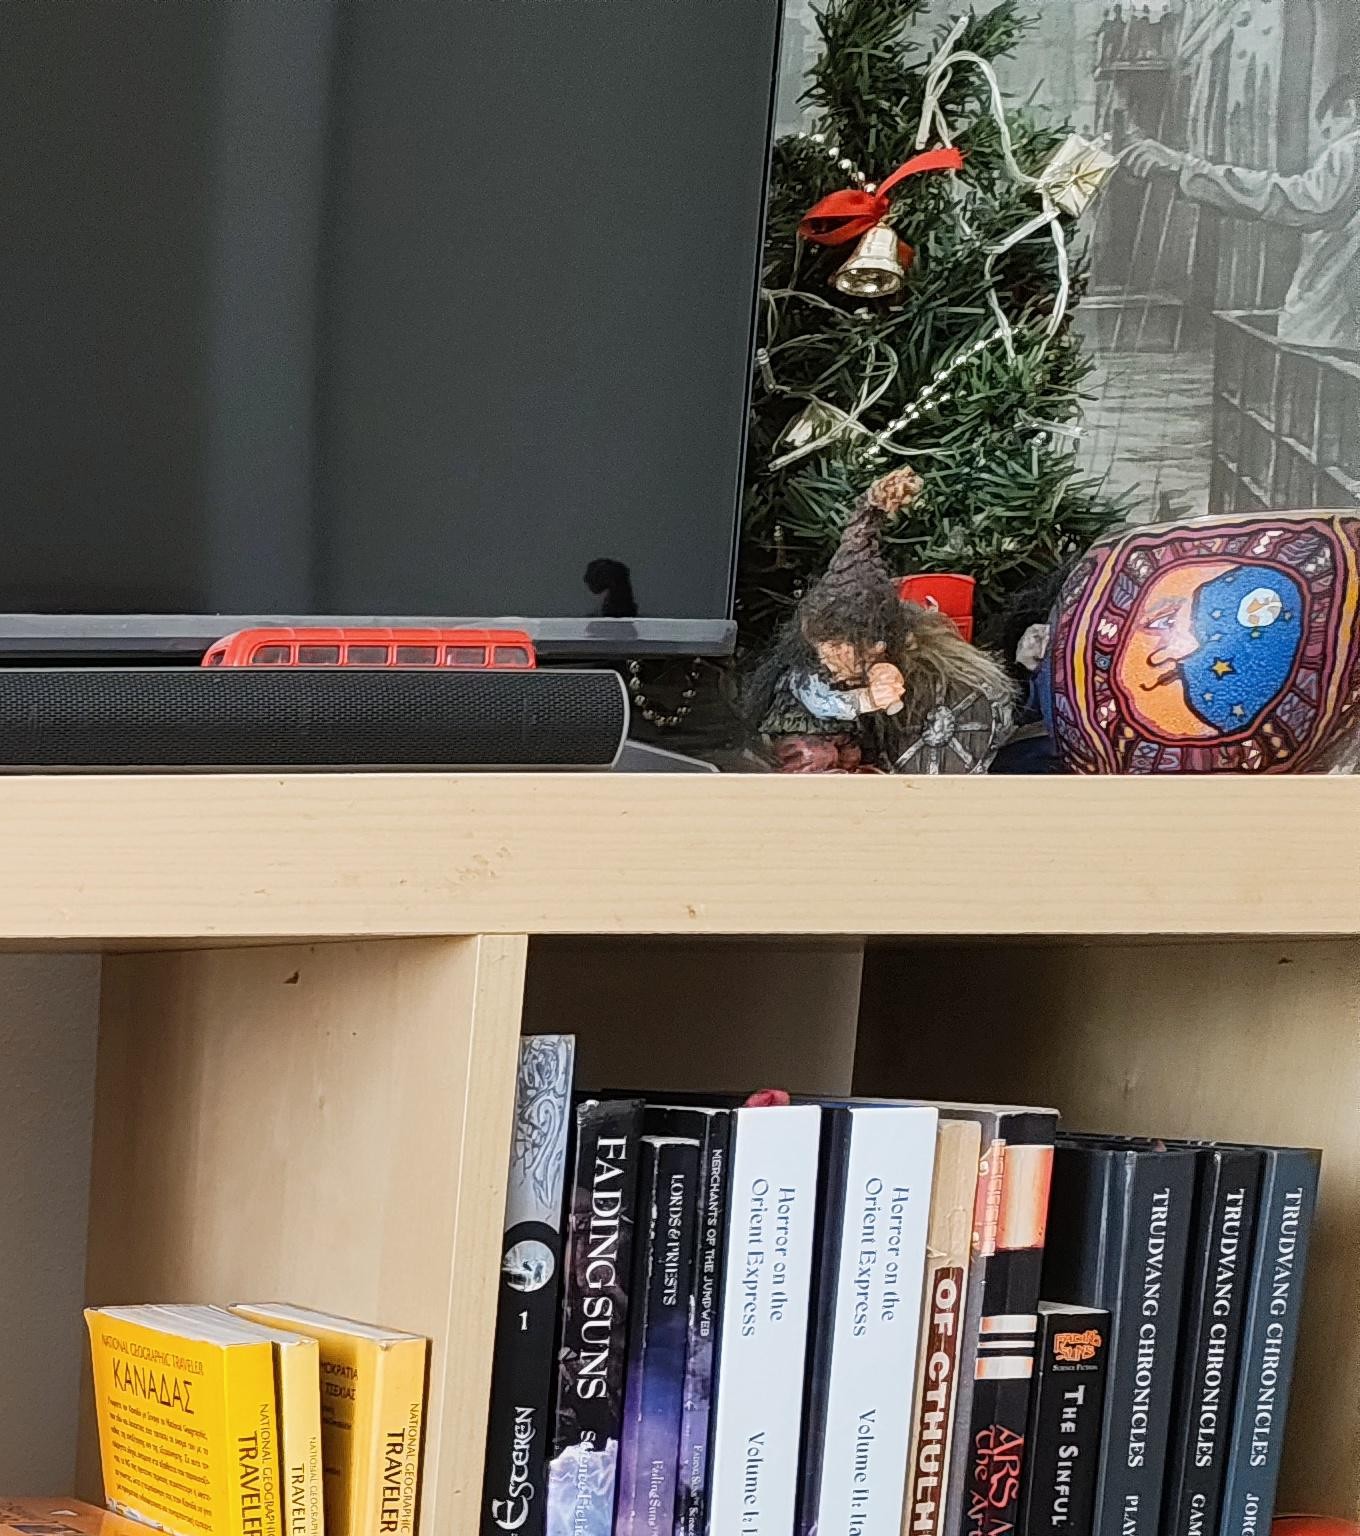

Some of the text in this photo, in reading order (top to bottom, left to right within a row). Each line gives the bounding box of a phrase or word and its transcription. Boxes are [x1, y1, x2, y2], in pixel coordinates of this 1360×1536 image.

[577, 1135, 627, 1400] FADING SUNS
[742, 1178, 769, 1337] Orient Express
[771, 1187, 796, 1256] Horror
[934, 1279, 957, 1337] OF
[1128, 1187, 1170, 1468] TRUDVANG CHRONICLES
[1249, 1187, 1303, 1467] TRUDVANG CHRONICLES
[1061, 1385, 1085, 1434] THE
[380, 1427, 407, 1535] TRAVELER
[1051, 1445, 1079, 1526] SINFUL
